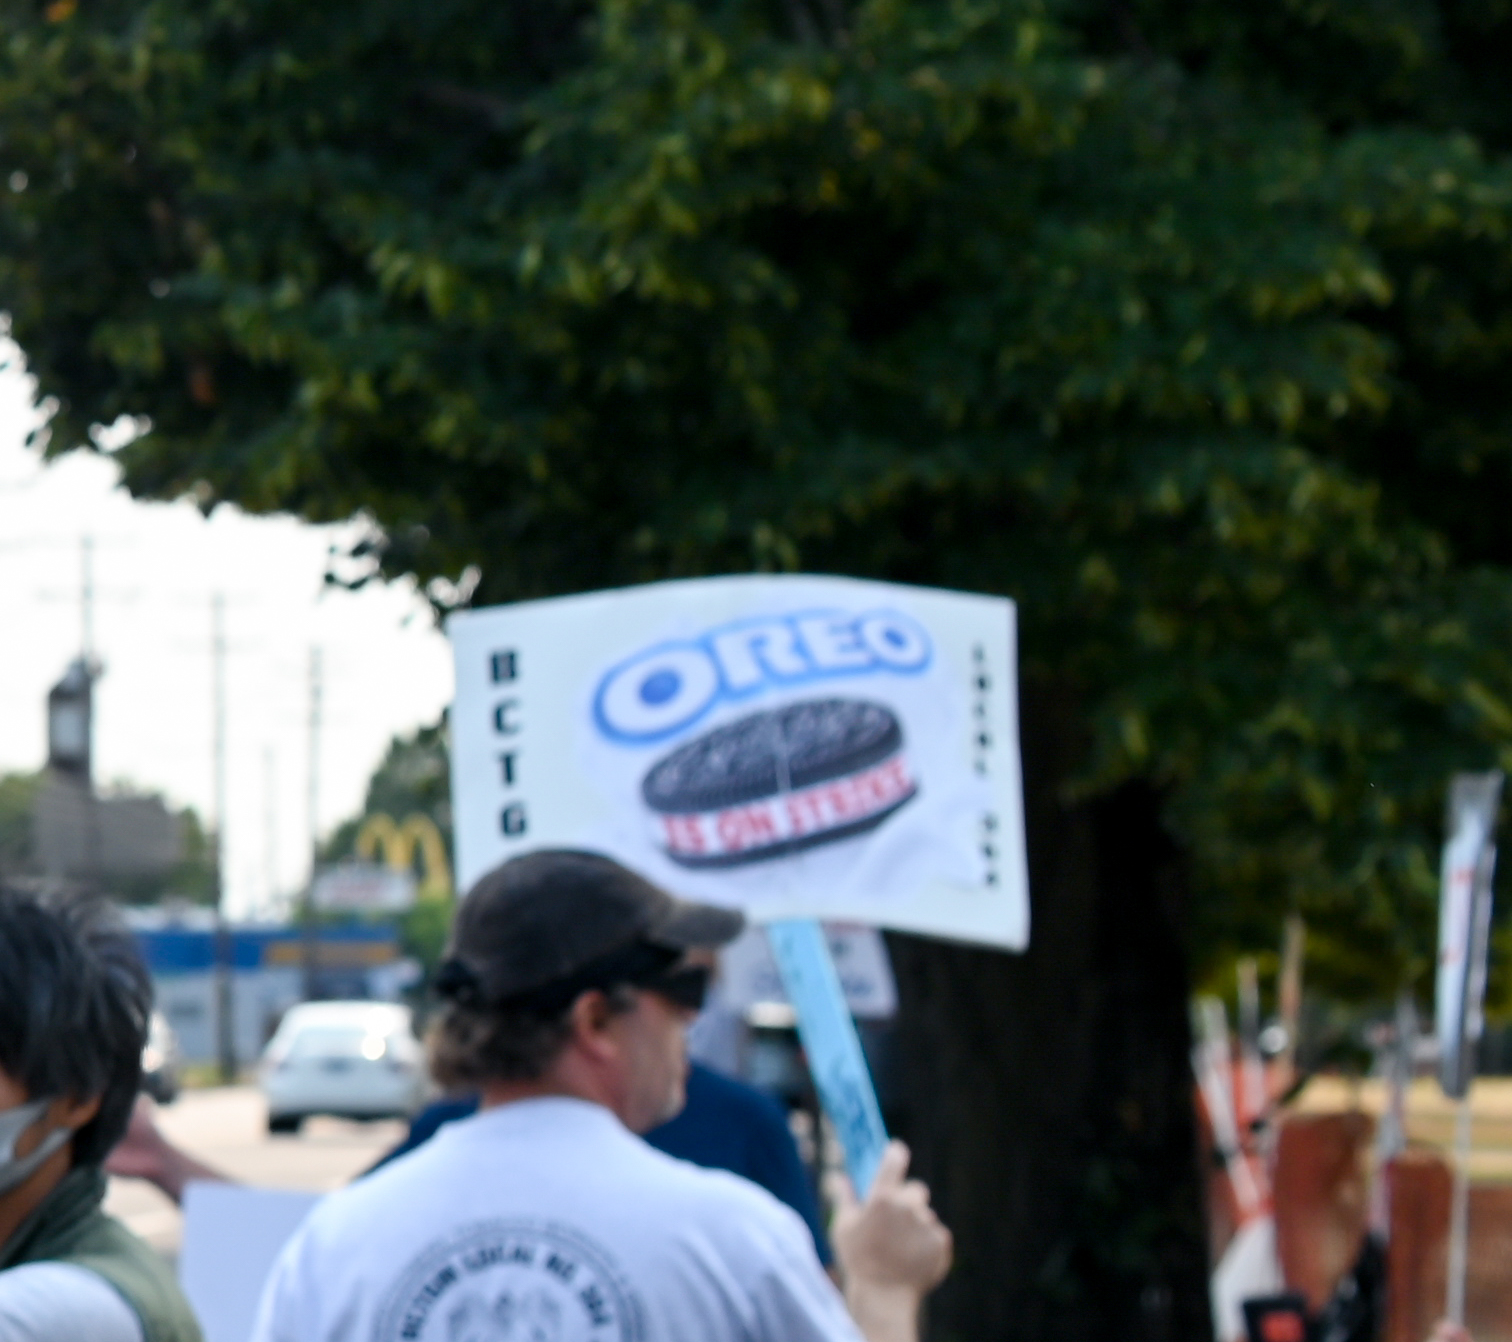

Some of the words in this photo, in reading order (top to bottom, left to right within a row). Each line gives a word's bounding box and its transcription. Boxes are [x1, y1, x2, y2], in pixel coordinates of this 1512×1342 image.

[591, 607, 935, 745] OREO
[664, 813, 706, 854] IS
[717, 804, 776, 852] ON
[785, 755, 911, 837] STRIKE
